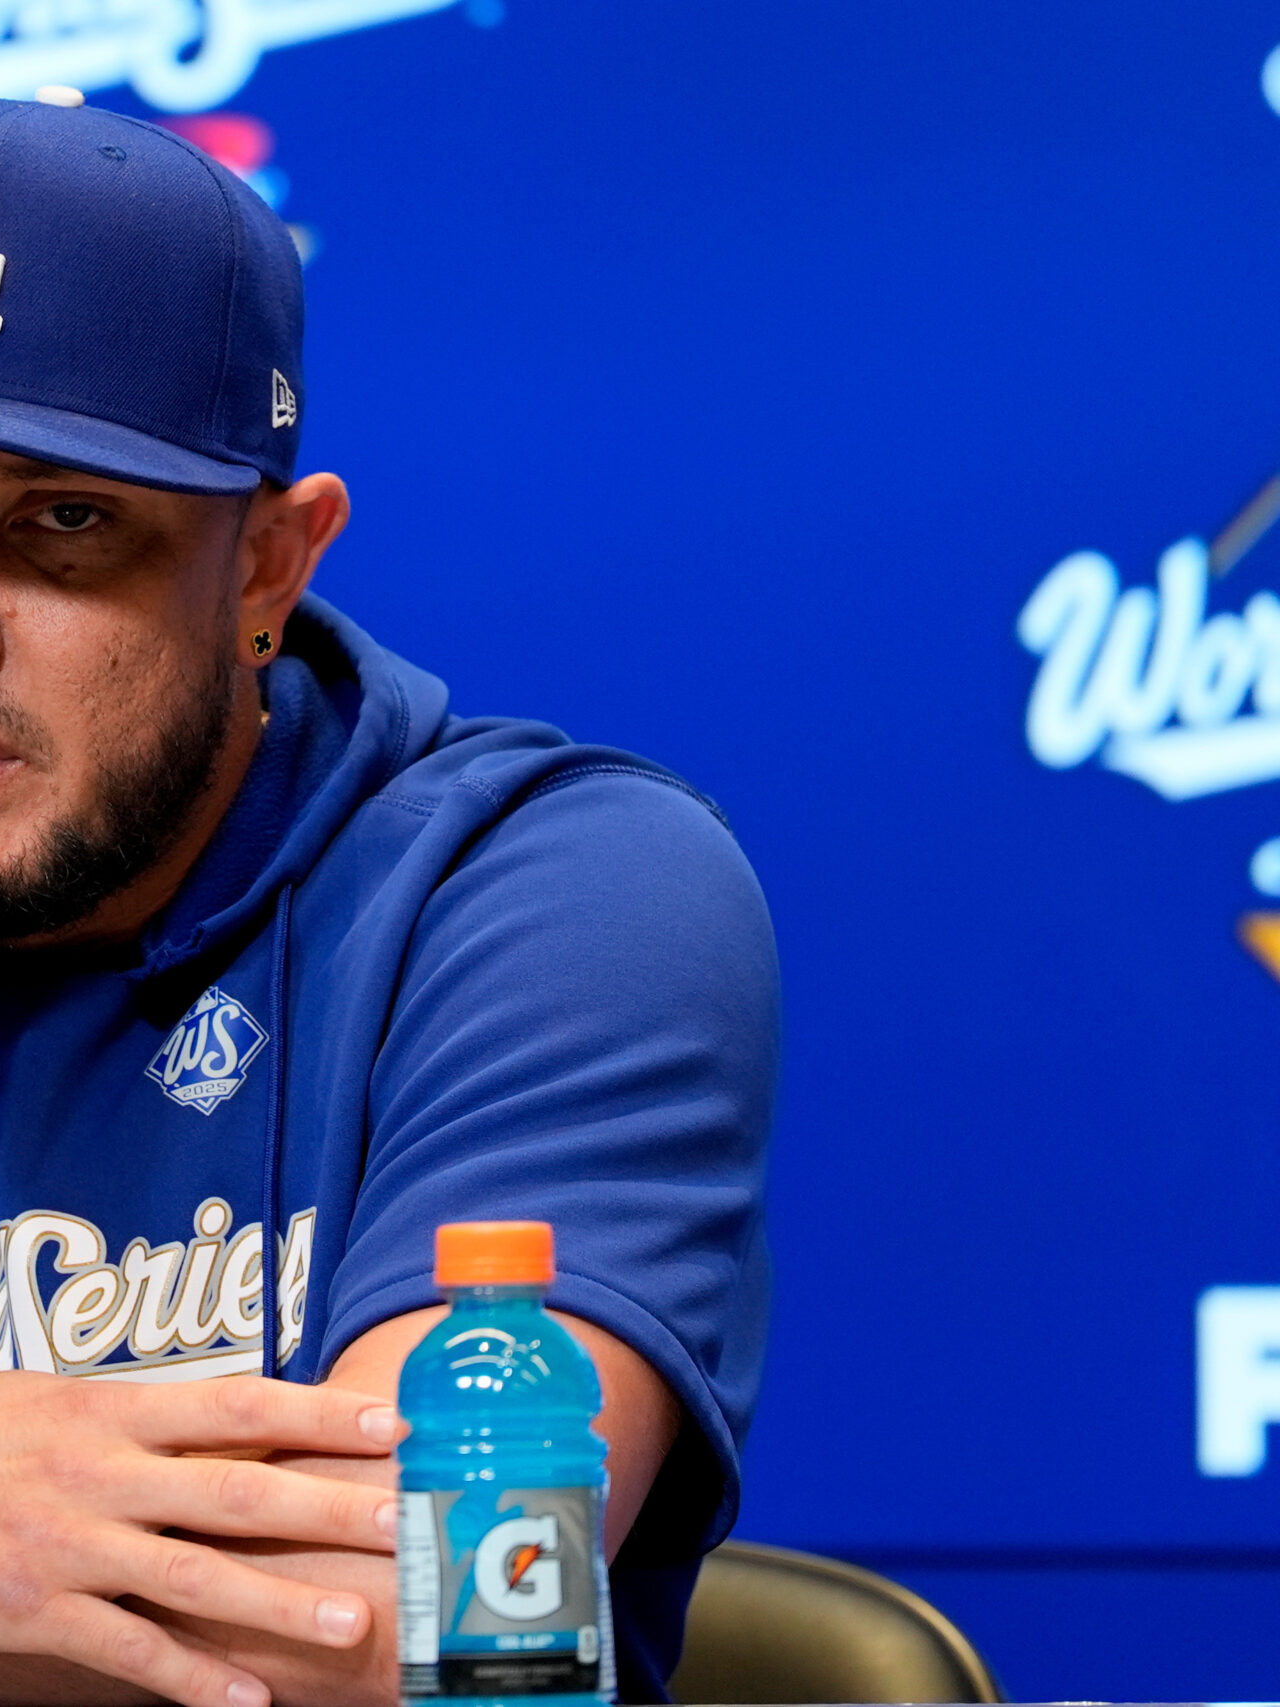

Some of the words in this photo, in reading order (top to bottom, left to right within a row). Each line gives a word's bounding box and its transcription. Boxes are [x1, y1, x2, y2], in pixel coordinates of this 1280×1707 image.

[162, 1004, 240, 1086] WS
[182, 1081, 228, 1098] 2025
[474, 1515, 562, 1620] G
